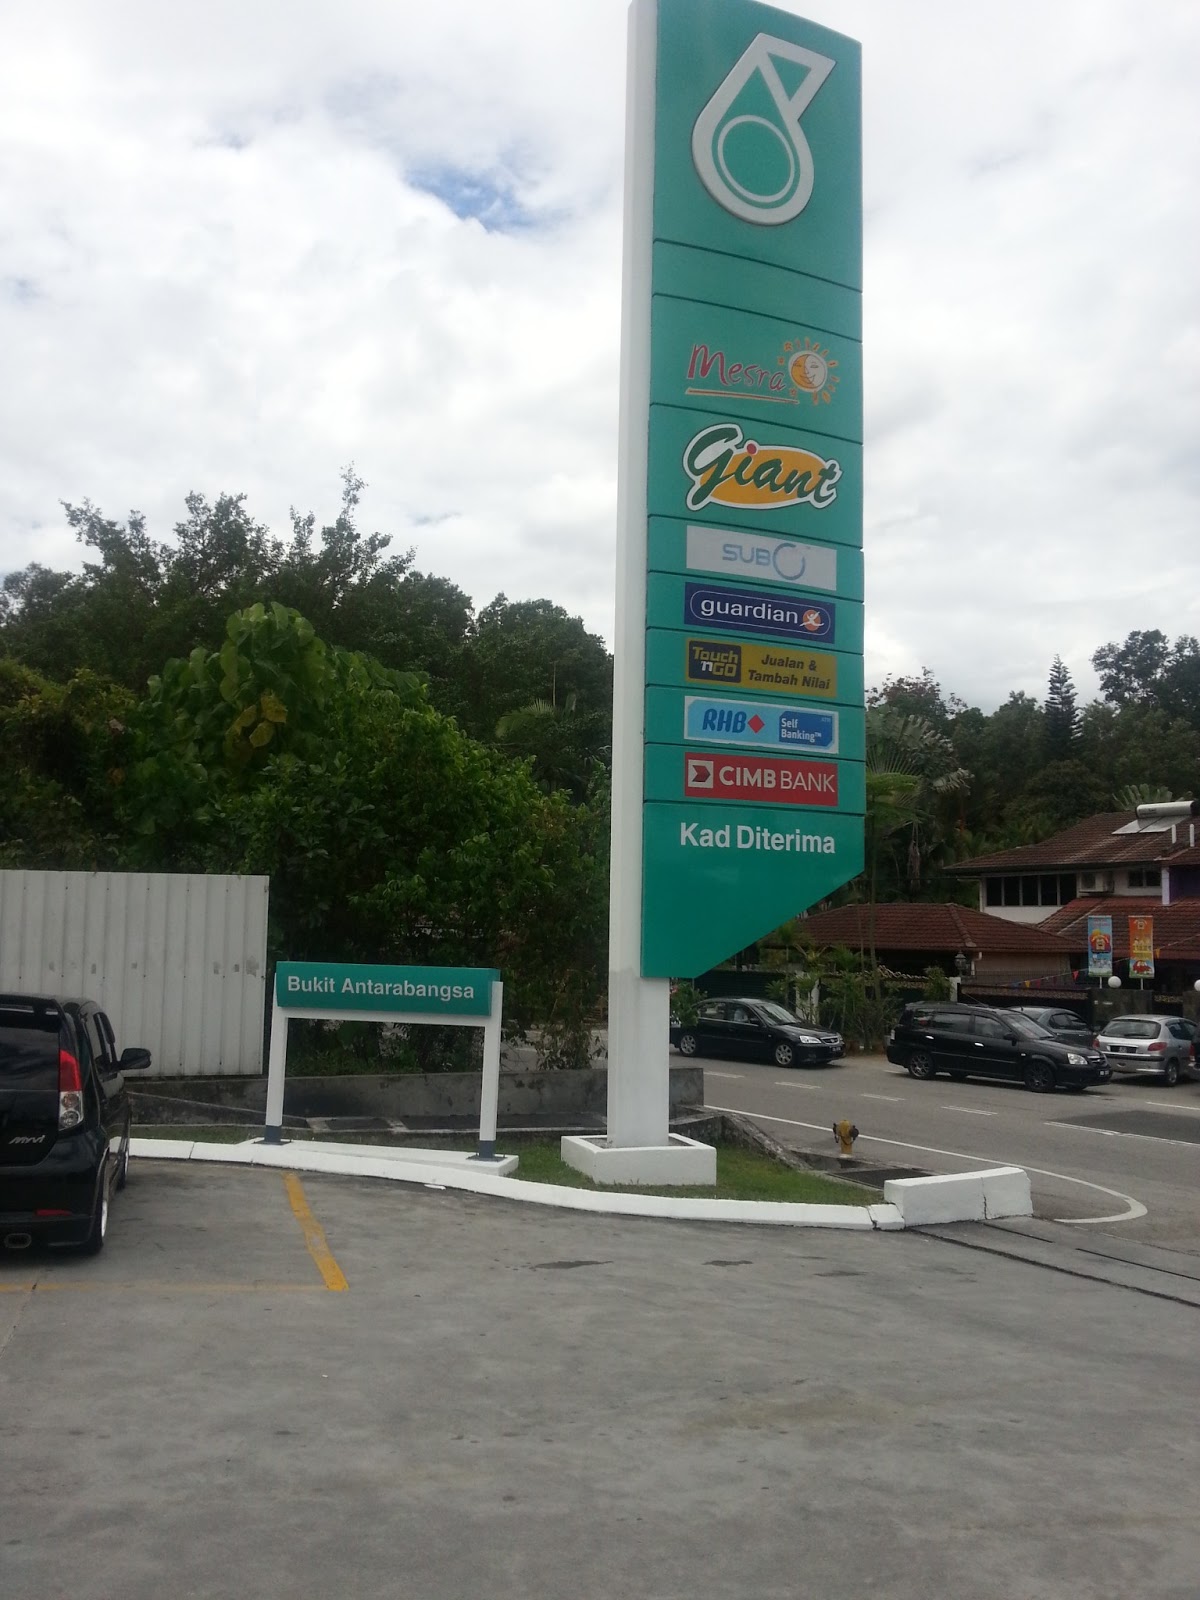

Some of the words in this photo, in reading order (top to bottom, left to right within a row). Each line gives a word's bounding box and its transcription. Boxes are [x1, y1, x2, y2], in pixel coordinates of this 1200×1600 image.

[687, 344, 786, 391] Mesra
[684, 424, 840, 508] Giant
[700, 599, 798, 624] guardian
[692, 646, 739, 664] Touch
[761, 654, 804, 670] Jualan
[808, 660, 817, 671] &
[748, 669, 798, 686] Tambah
[802, 675, 830, 690] Nilai
[702, 708, 747, 734] RHB
[781, 717, 798, 729] Self
[719, 766, 776, 789] CIMB
[780, 770, 836, 793] BANK
[680, 822, 731, 848] Kad
[737, 825, 836, 854] Diterima
[287, 975, 336, 993] Bukit
[341, 977, 475, 1002] Antarabangsa
